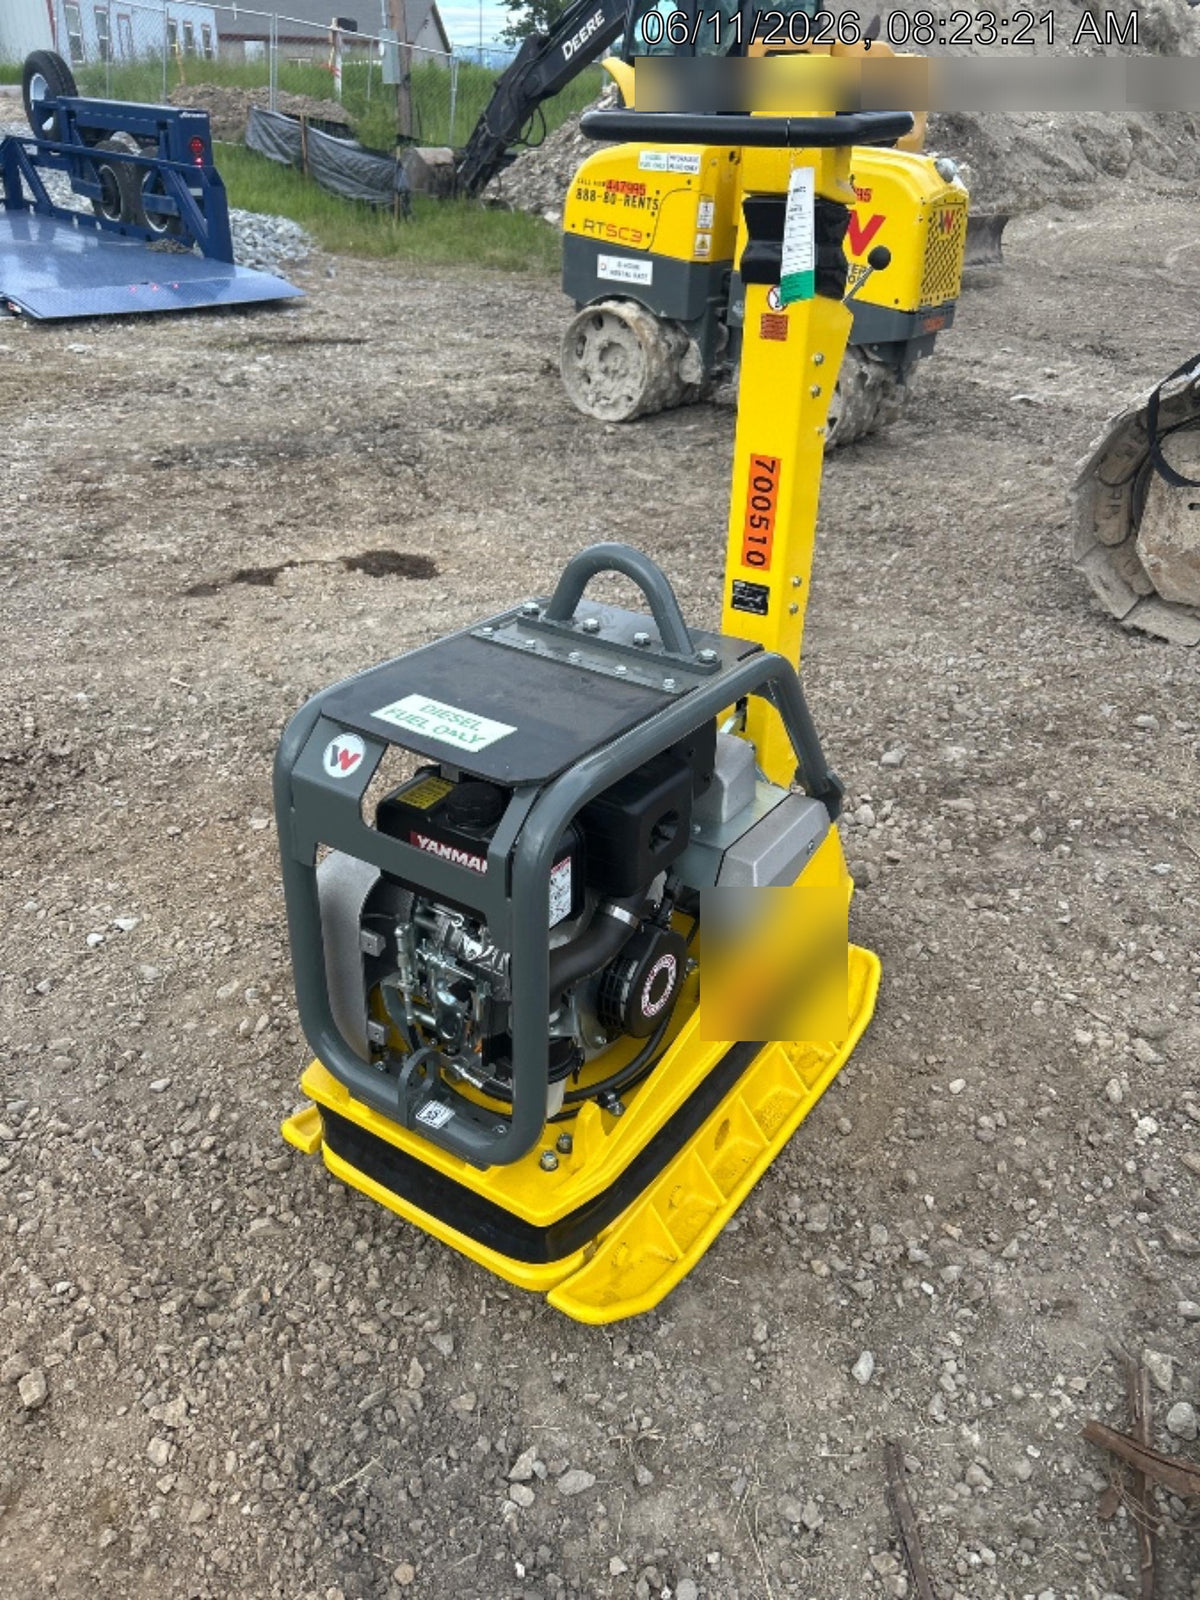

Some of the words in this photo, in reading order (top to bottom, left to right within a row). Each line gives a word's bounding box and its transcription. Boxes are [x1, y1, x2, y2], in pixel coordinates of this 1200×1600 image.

[561, 8, 606, 61] DEERE
[746, 460, 776, 567] 700510
[384, 706, 430, 730] FUEL
[432, 724, 486, 745] ONLY
[419, 704, 482, 732] DIESEL
